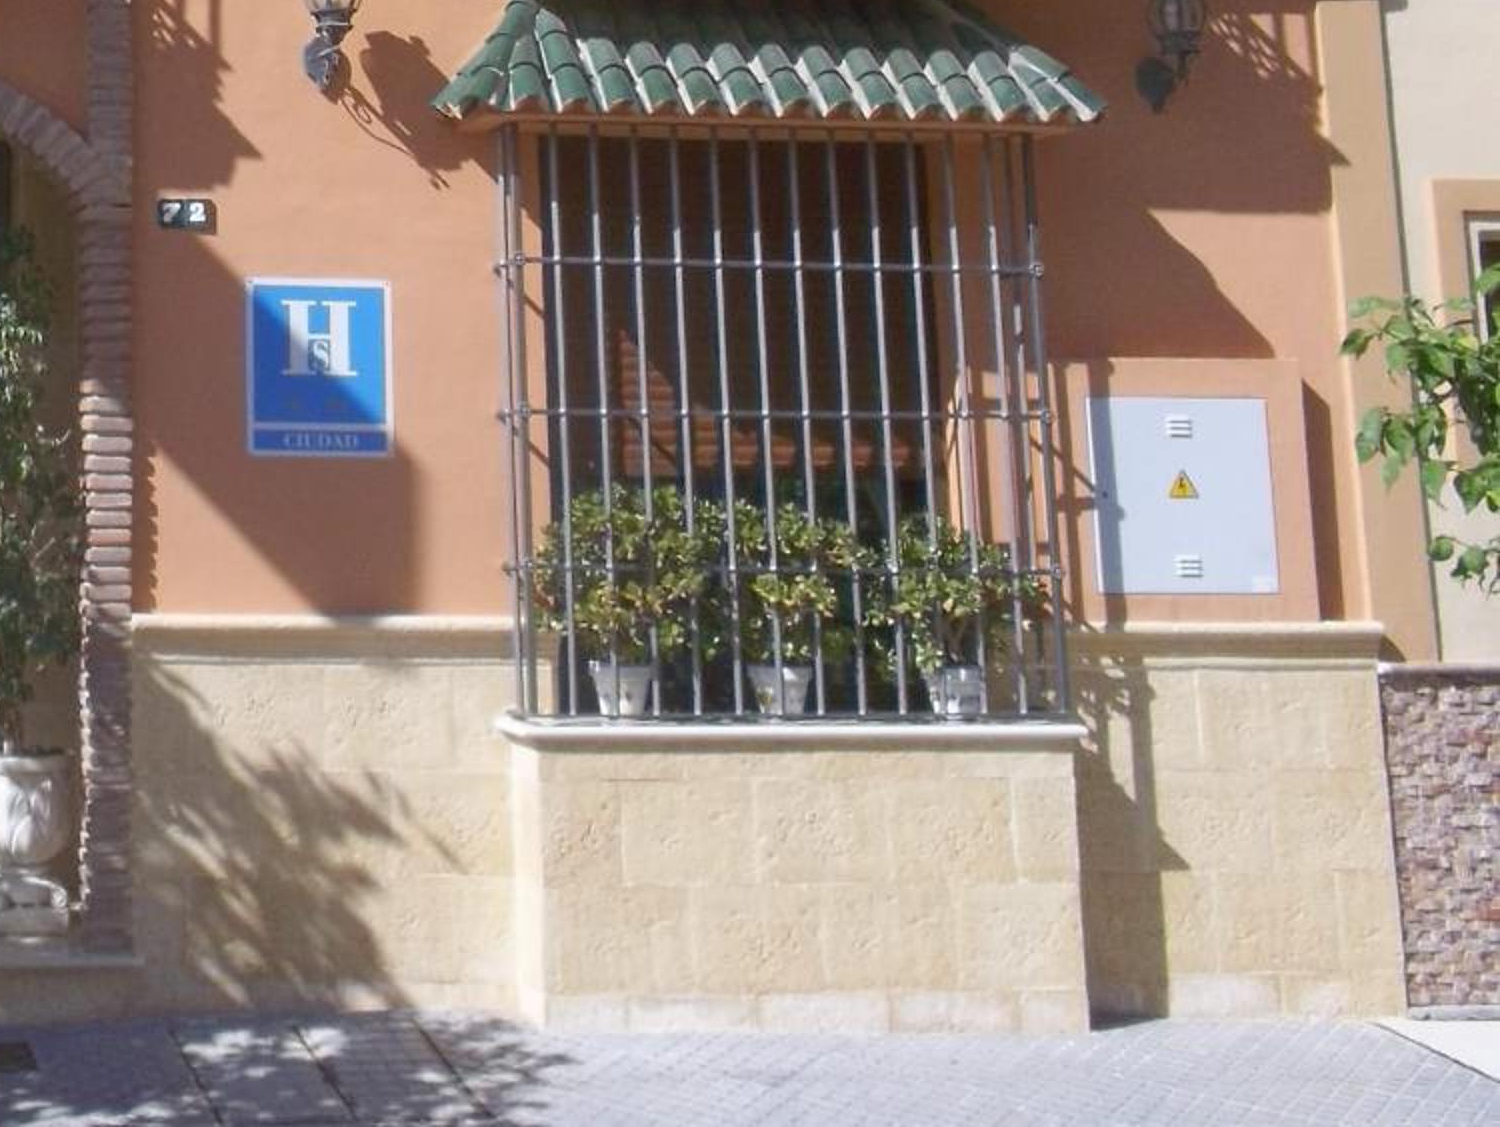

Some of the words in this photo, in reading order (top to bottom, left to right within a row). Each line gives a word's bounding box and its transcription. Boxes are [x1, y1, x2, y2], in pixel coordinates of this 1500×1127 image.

[162, 202, 206, 223] 72
[281, 299, 357, 376] H
[283, 433, 357, 448] CIUDAD
